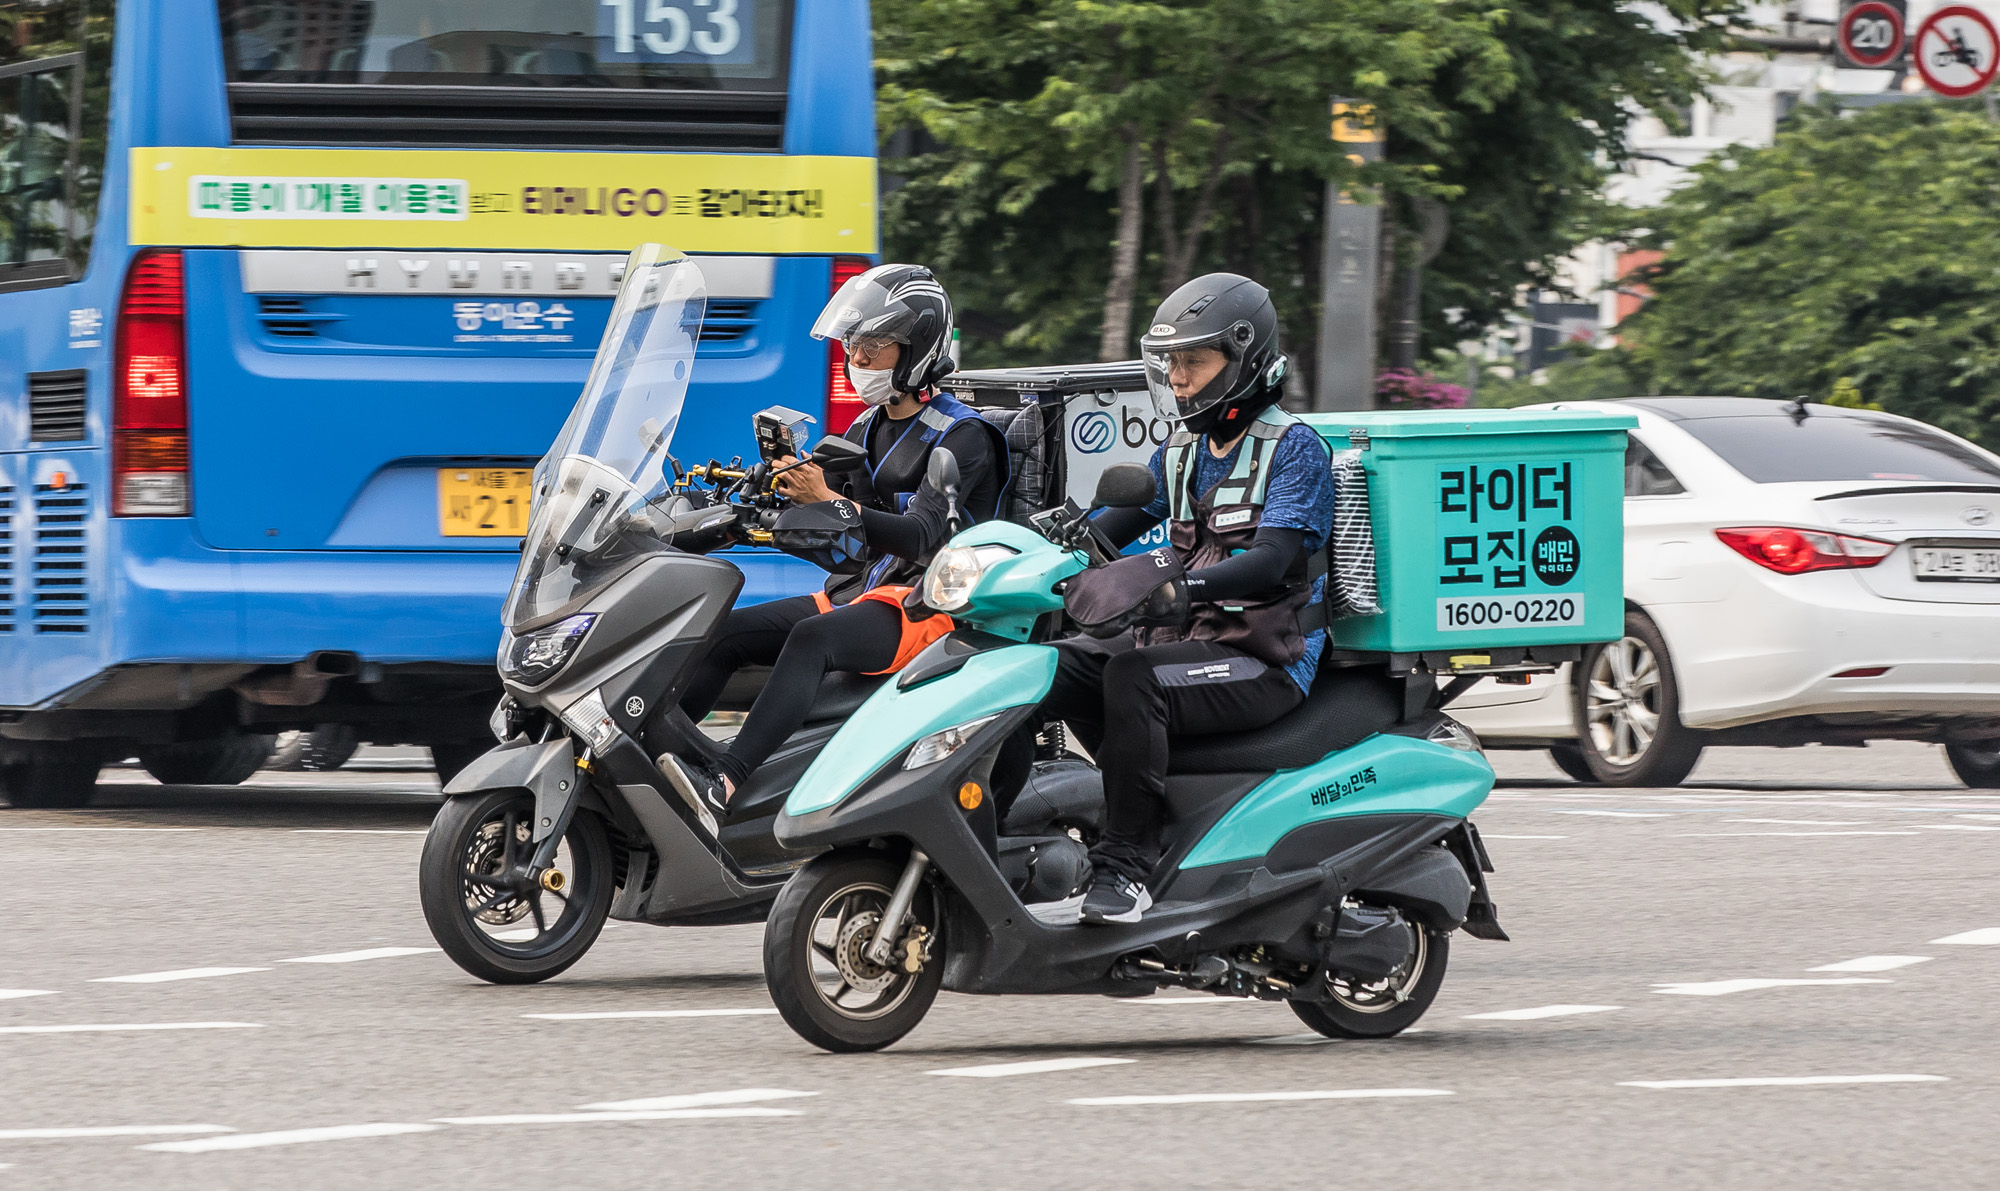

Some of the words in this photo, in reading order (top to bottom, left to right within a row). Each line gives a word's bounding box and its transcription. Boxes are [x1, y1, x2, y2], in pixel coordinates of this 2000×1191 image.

[601, 0, 741, 55] 153
[1851, 18, 1895, 48] 20
[511, 471, 532, 488] 7
[1440, 462, 1572, 523] 라이더
[473, 494, 531, 529] 21
[1440, 528, 1527, 588] 모집
[1538, 540, 1573, 563] 배민
[1445, 598, 1575, 626] 1600-0220
[1310, 766, 1377, 806] 배달의민족
